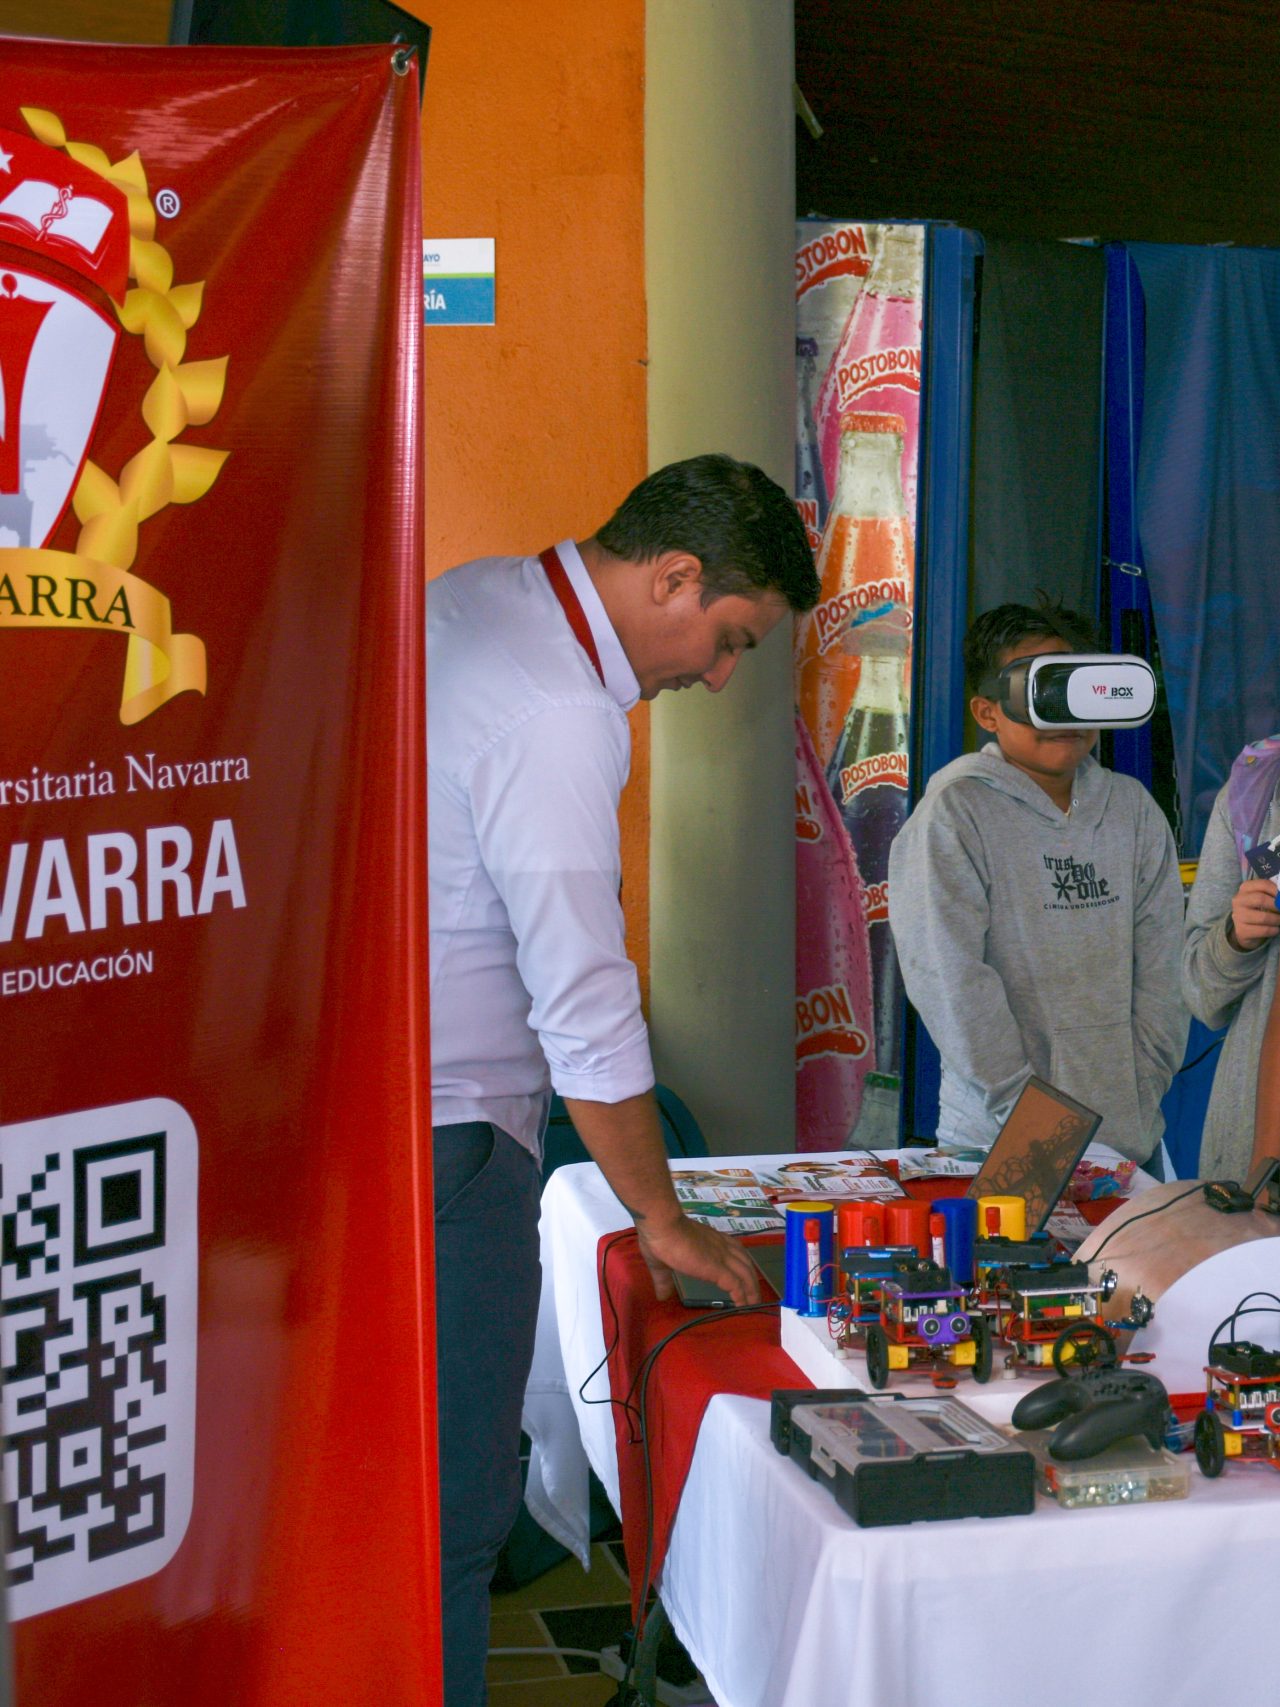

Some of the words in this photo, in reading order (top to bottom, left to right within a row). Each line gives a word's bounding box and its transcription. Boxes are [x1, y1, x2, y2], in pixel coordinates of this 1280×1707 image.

[838, 349, 921, 395] POSTOBON
[1092, 685, 1107, 695] VR
[1111, 687, 1134, 697] BOX
[124, 753, 250, 792] Navarra
[841, 754, 908, 794] POSTOBON
[2, 948, 153, 996] EDUCACIÓN
